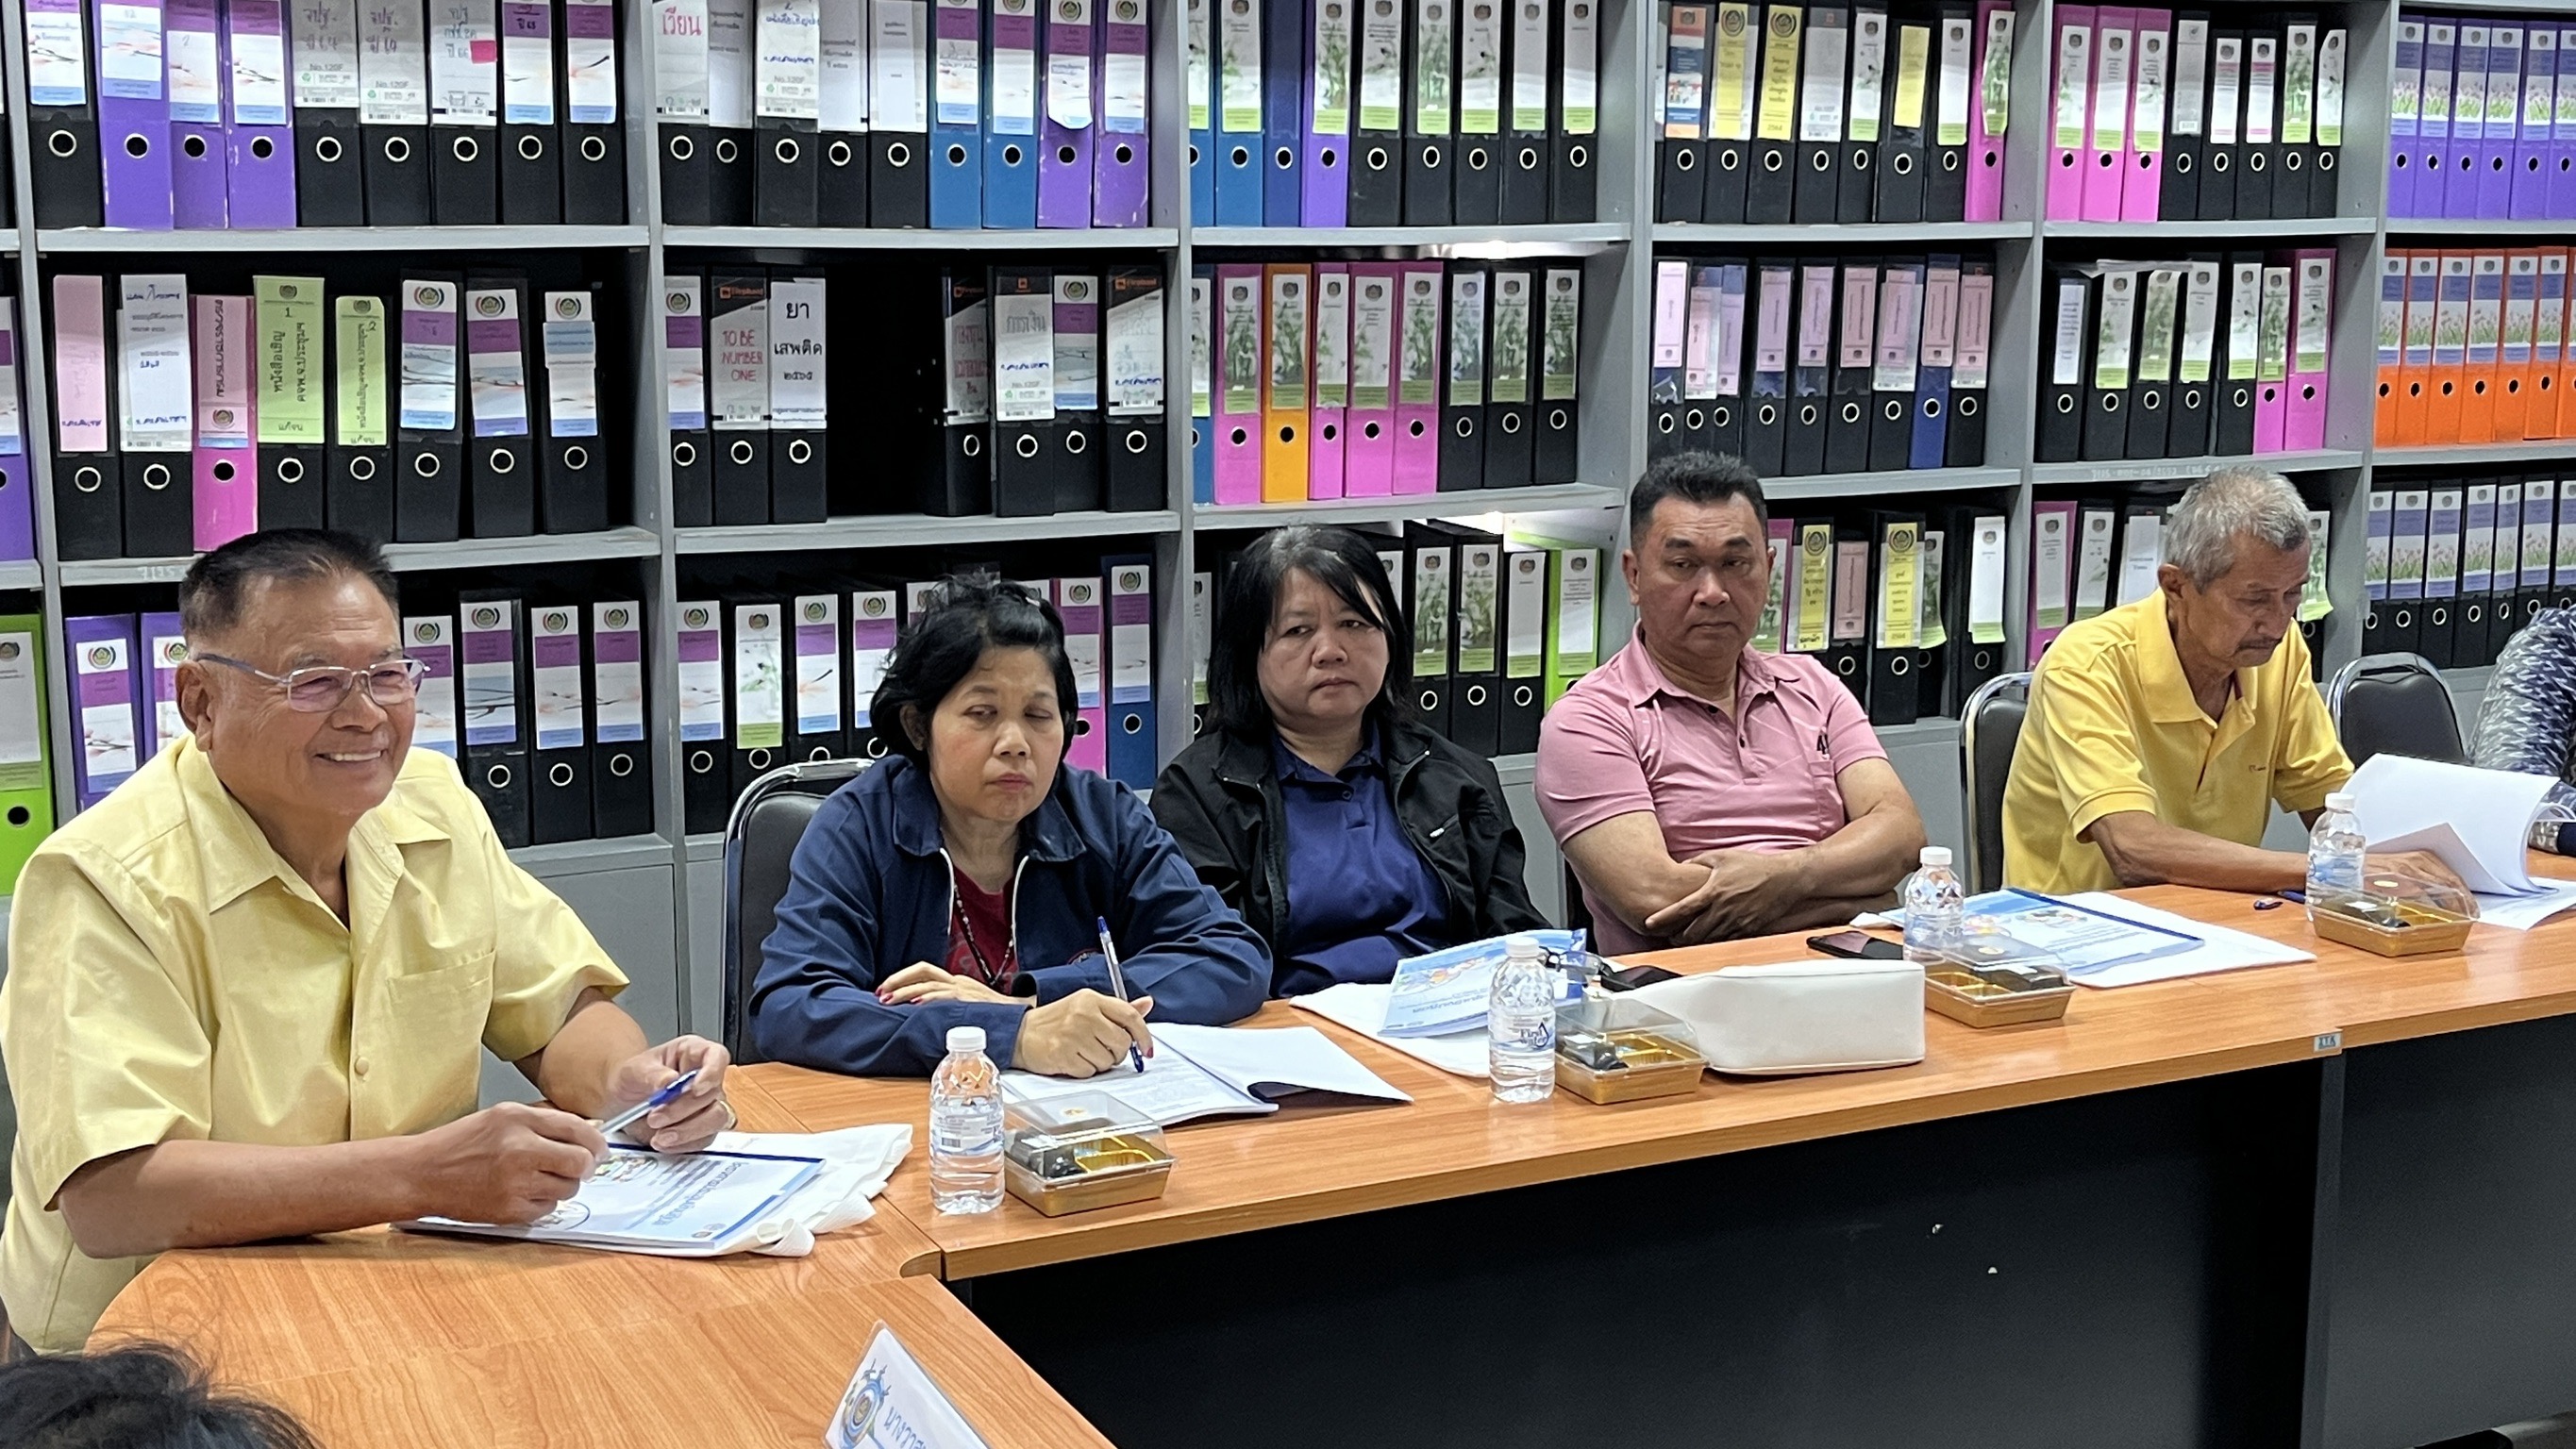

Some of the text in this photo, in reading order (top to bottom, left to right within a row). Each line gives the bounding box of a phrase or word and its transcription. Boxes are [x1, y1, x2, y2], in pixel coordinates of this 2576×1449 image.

[662, 6, 702, 36] เวียน
[285, 307, 293, 318] 1
[786, 302, 810, 319] ยา
[722, 329, 756, 346] TO BE
[774, 339, 823, 356] เสพติด
[722, 351, 763, 365] NUMBER
[731, 369, 757, 382] ONE
[784, 371, 812, 380] ๒๕๖๕
